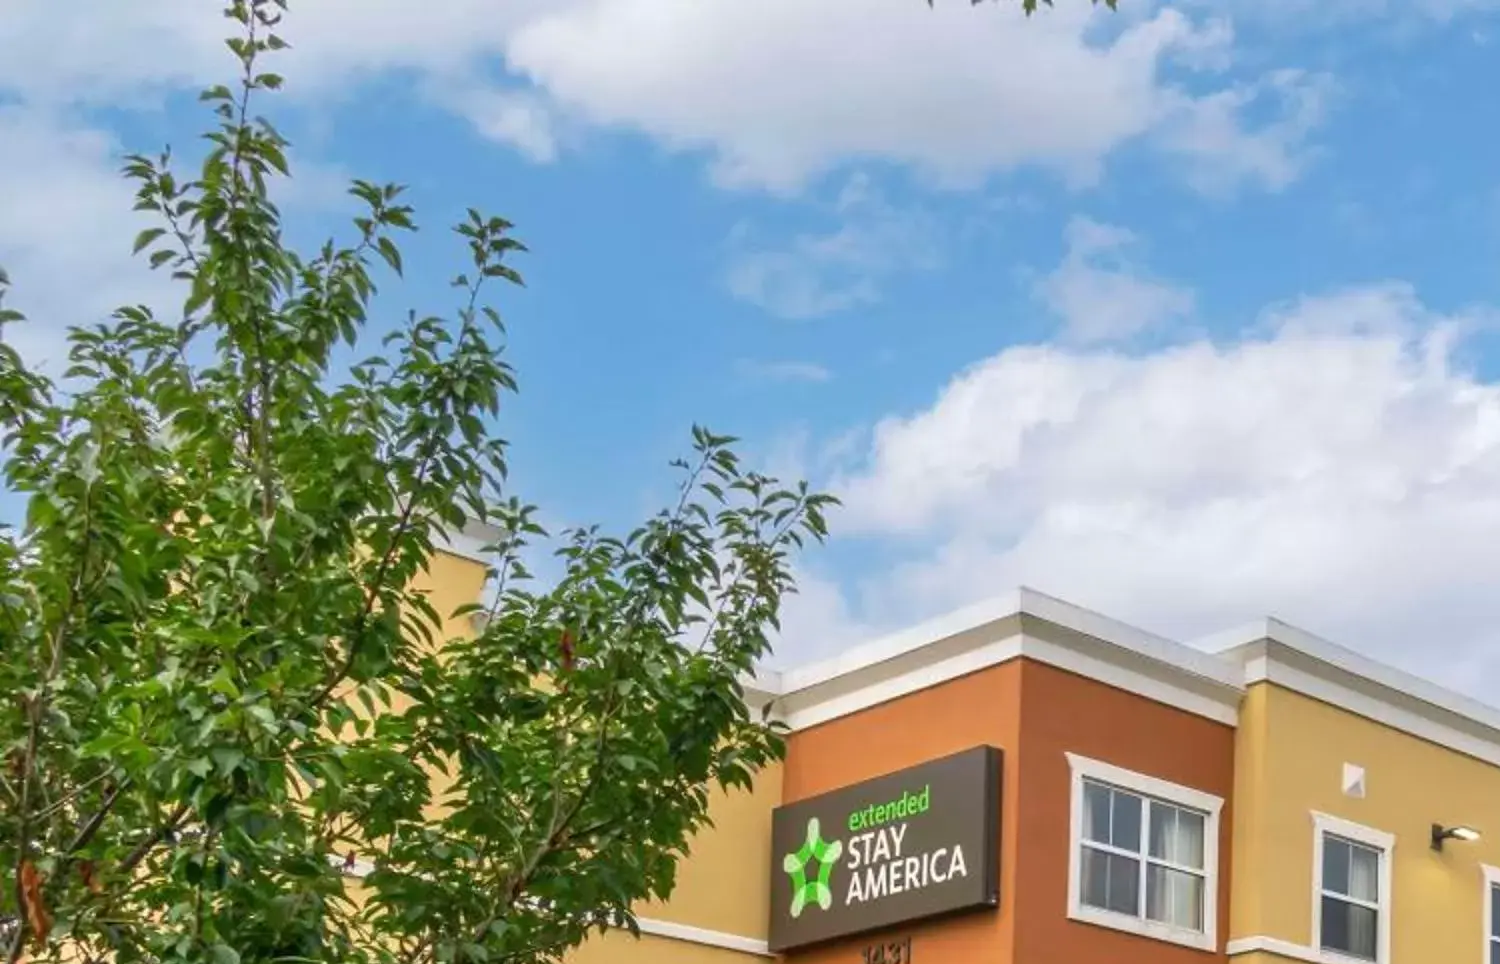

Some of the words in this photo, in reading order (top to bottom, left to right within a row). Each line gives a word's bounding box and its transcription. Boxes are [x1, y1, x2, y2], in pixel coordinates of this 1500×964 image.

[848, 784, 929, 831] extended
[847, 823, 908, 870] STAY
[845, 844, 968, 906] AMERICA
